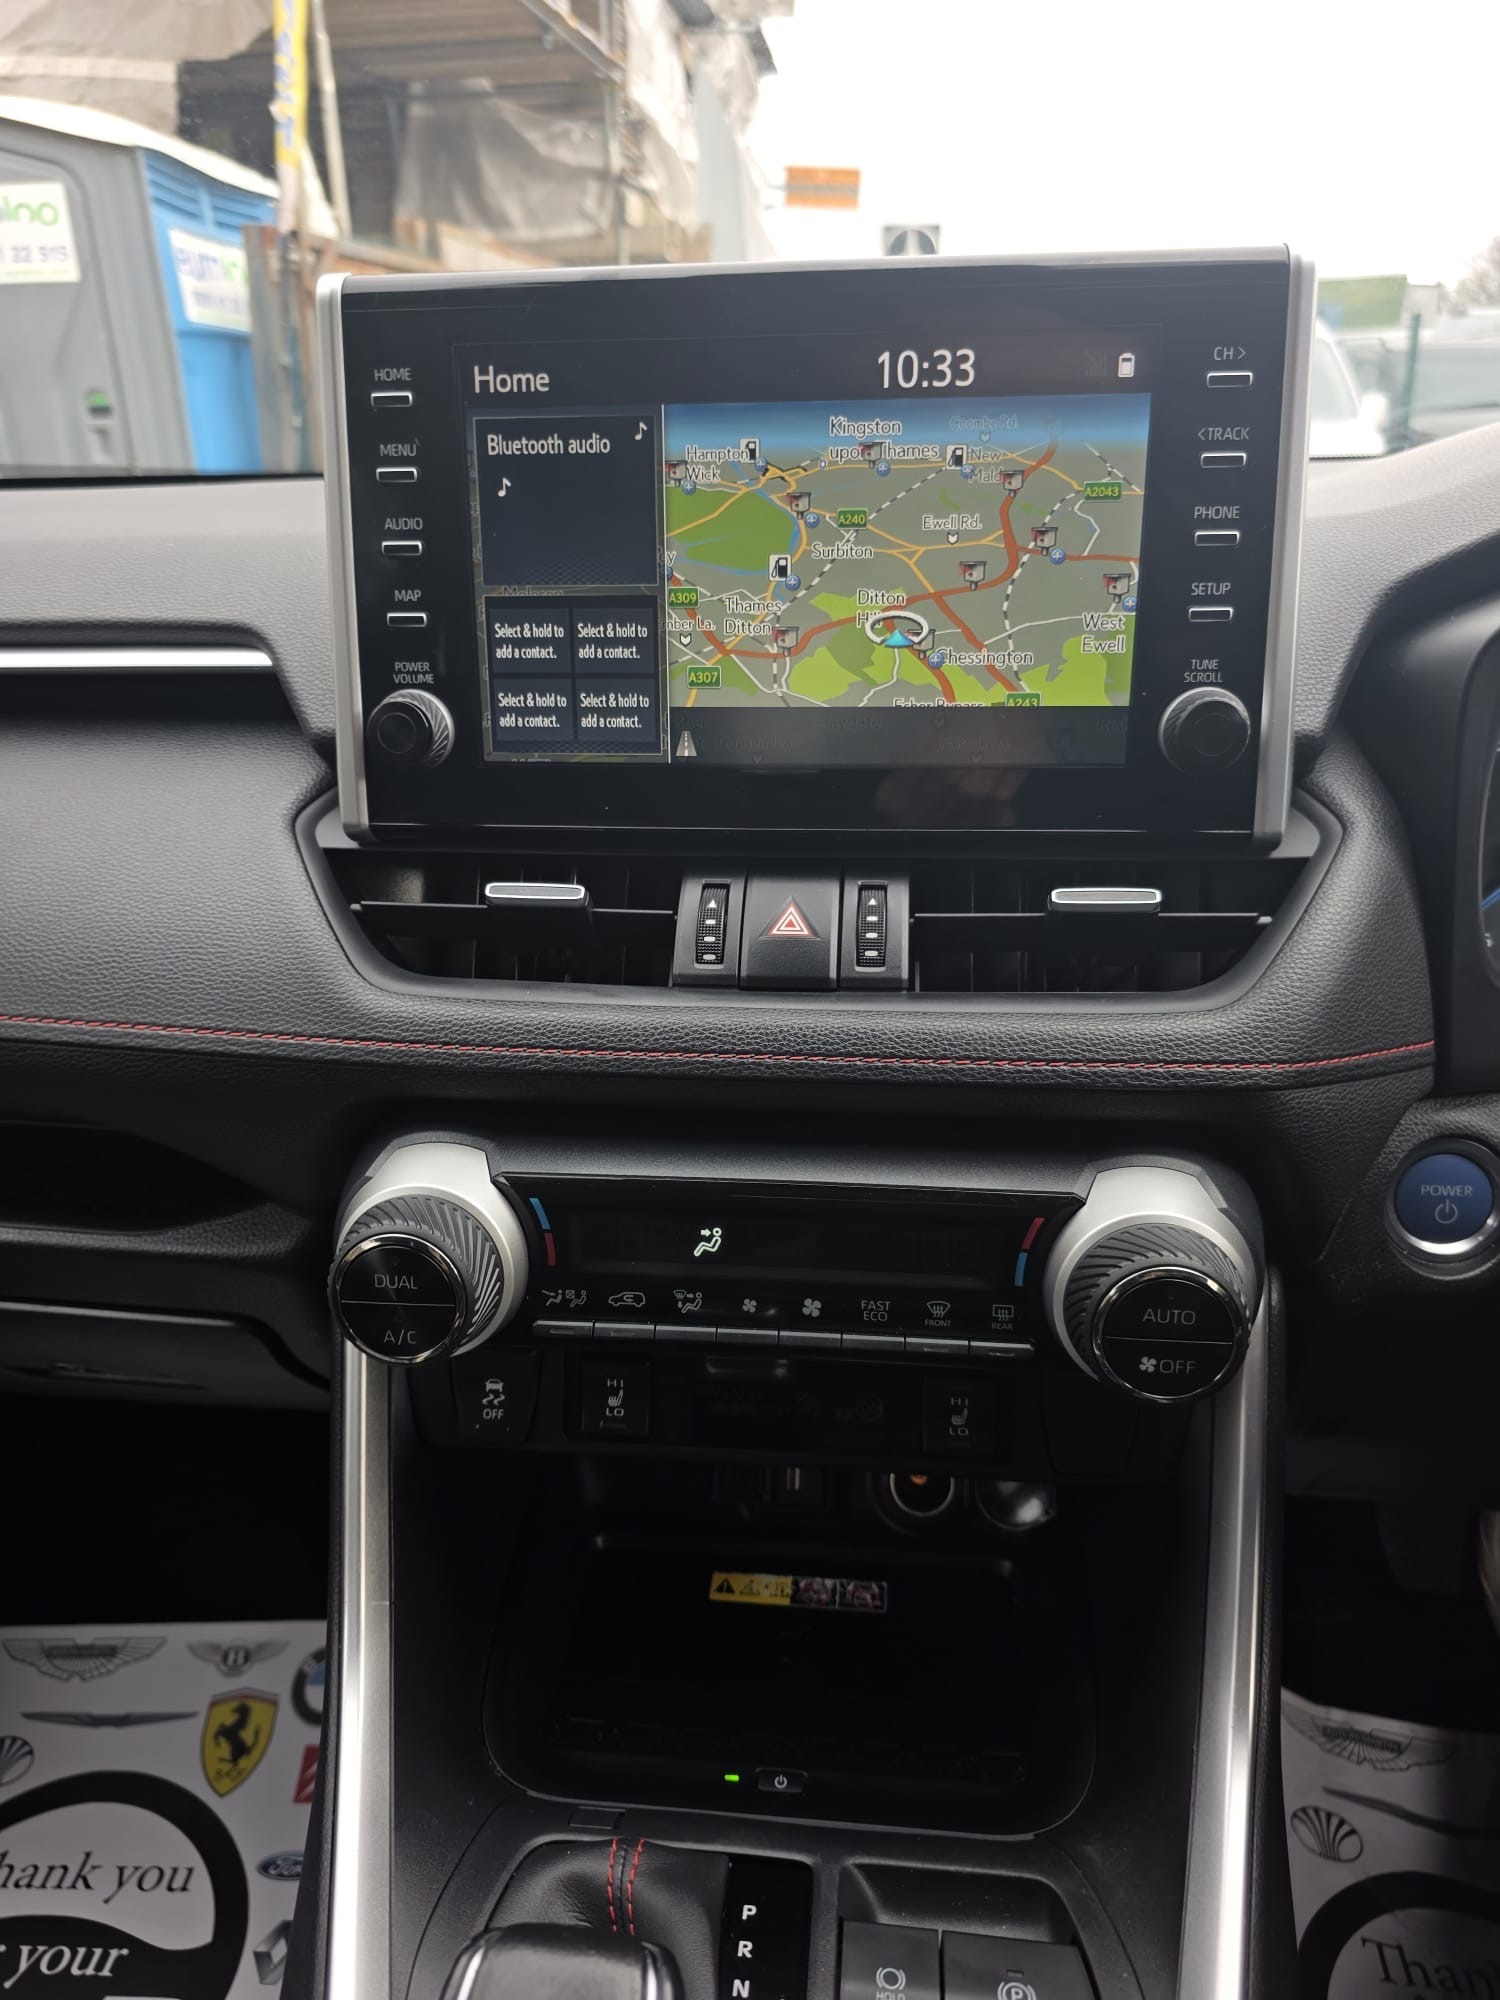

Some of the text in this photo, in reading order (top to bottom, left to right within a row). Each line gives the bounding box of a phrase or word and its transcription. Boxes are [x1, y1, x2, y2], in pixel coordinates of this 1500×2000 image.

[374, 368, 412, 381] HOME
[877, 348, 976, 389] 10:33
[473, 365, 550, 393] Home
[829, 416, 902, 438] Kingston
[380, 444, 417, 457] MENU
[487, 432, 611, 456] Bluetooth audio
[686, 445, 750, 463] Hampton
[829, 447, 863, 464] upo
[969, 446, 1001, 462] New
[686, 465, 720, 482] Wick
[1085, 486, 1120, 497] A2043
[838, 514, 865, 525] A240
[1194, 506, 1241, 519] PHONE
[384, 517, 424, 530] AUDIO
[922, 515, 983, 530] Ewell Rd.
[811, 543, 873, 559] Surbiton
[394, 590, 422, 602] MAP
[1191, 582, 1231, 595] SETUP
[669, 593, 697, 603] A309
[857, 589, 905, 605] Ditton
[723, 596, 782, 614] Thames
[724, 618, 772, 635] Ditton
[1082, 612, 1125, 630] West
[494, 623, 564, 638] Select & hold to
[577, 623, 648, 638] Select & hold to
[496, 645, 512, 659] add
[521, 646, 557, 659] contact.
[578, 645, 595, 659] add
[604, 646, 640, 659] contact.
[1081, 636, 1125, 653] Ewell
[936, 648, 1033, 669] Chessington
[1191, 660, 1219, 670] TUNE
[394, 662, 430, 672] POWER
[393, 674, 435, 684] VOLUME
[688, 672, 718, 682] A307
[1183, 672, 1223, 683] SCROLL
[498, 692, 567, 707] Select & hold to
[580, 693, 650, 708] Select & hold to
[499, 713, 516, 727] add
[524, 714, 560, 727] contact.
[581, 714, 598, 728] add
[606, 715, 642, 728] contact.
[1420, 1184, 1473, 1197] POWER
[374, 1274, 418, 1290] DUAL
[861, 1300, 891, 1311] FAST
[863, 1311, 888, 1322] ECO
[925, 1319, 952, 1328] FRONT
[1142, 1308, 1196, 1325] AUTO
[991, 1322, 1013, 1331] REAR
[383, 1328, 417, 1345] A/C
[1159, 1359, 1197, 1374] OFF
[607, 1378, 624, 1388] HI
[951, 1397, 969, 1407] HI
[482, 1408, 504, 1420] OFF
[606, 1408, 624, 1417] LO
[949, 1427, 969, 1437] LO
[103, 1862, 195, 1904] you
[741, 1905, 758, 1921] P
[737, 1941, 753, 1959] R
[3, 1944, 130, 1989] your
[731, 1979, 751, 1998] N
